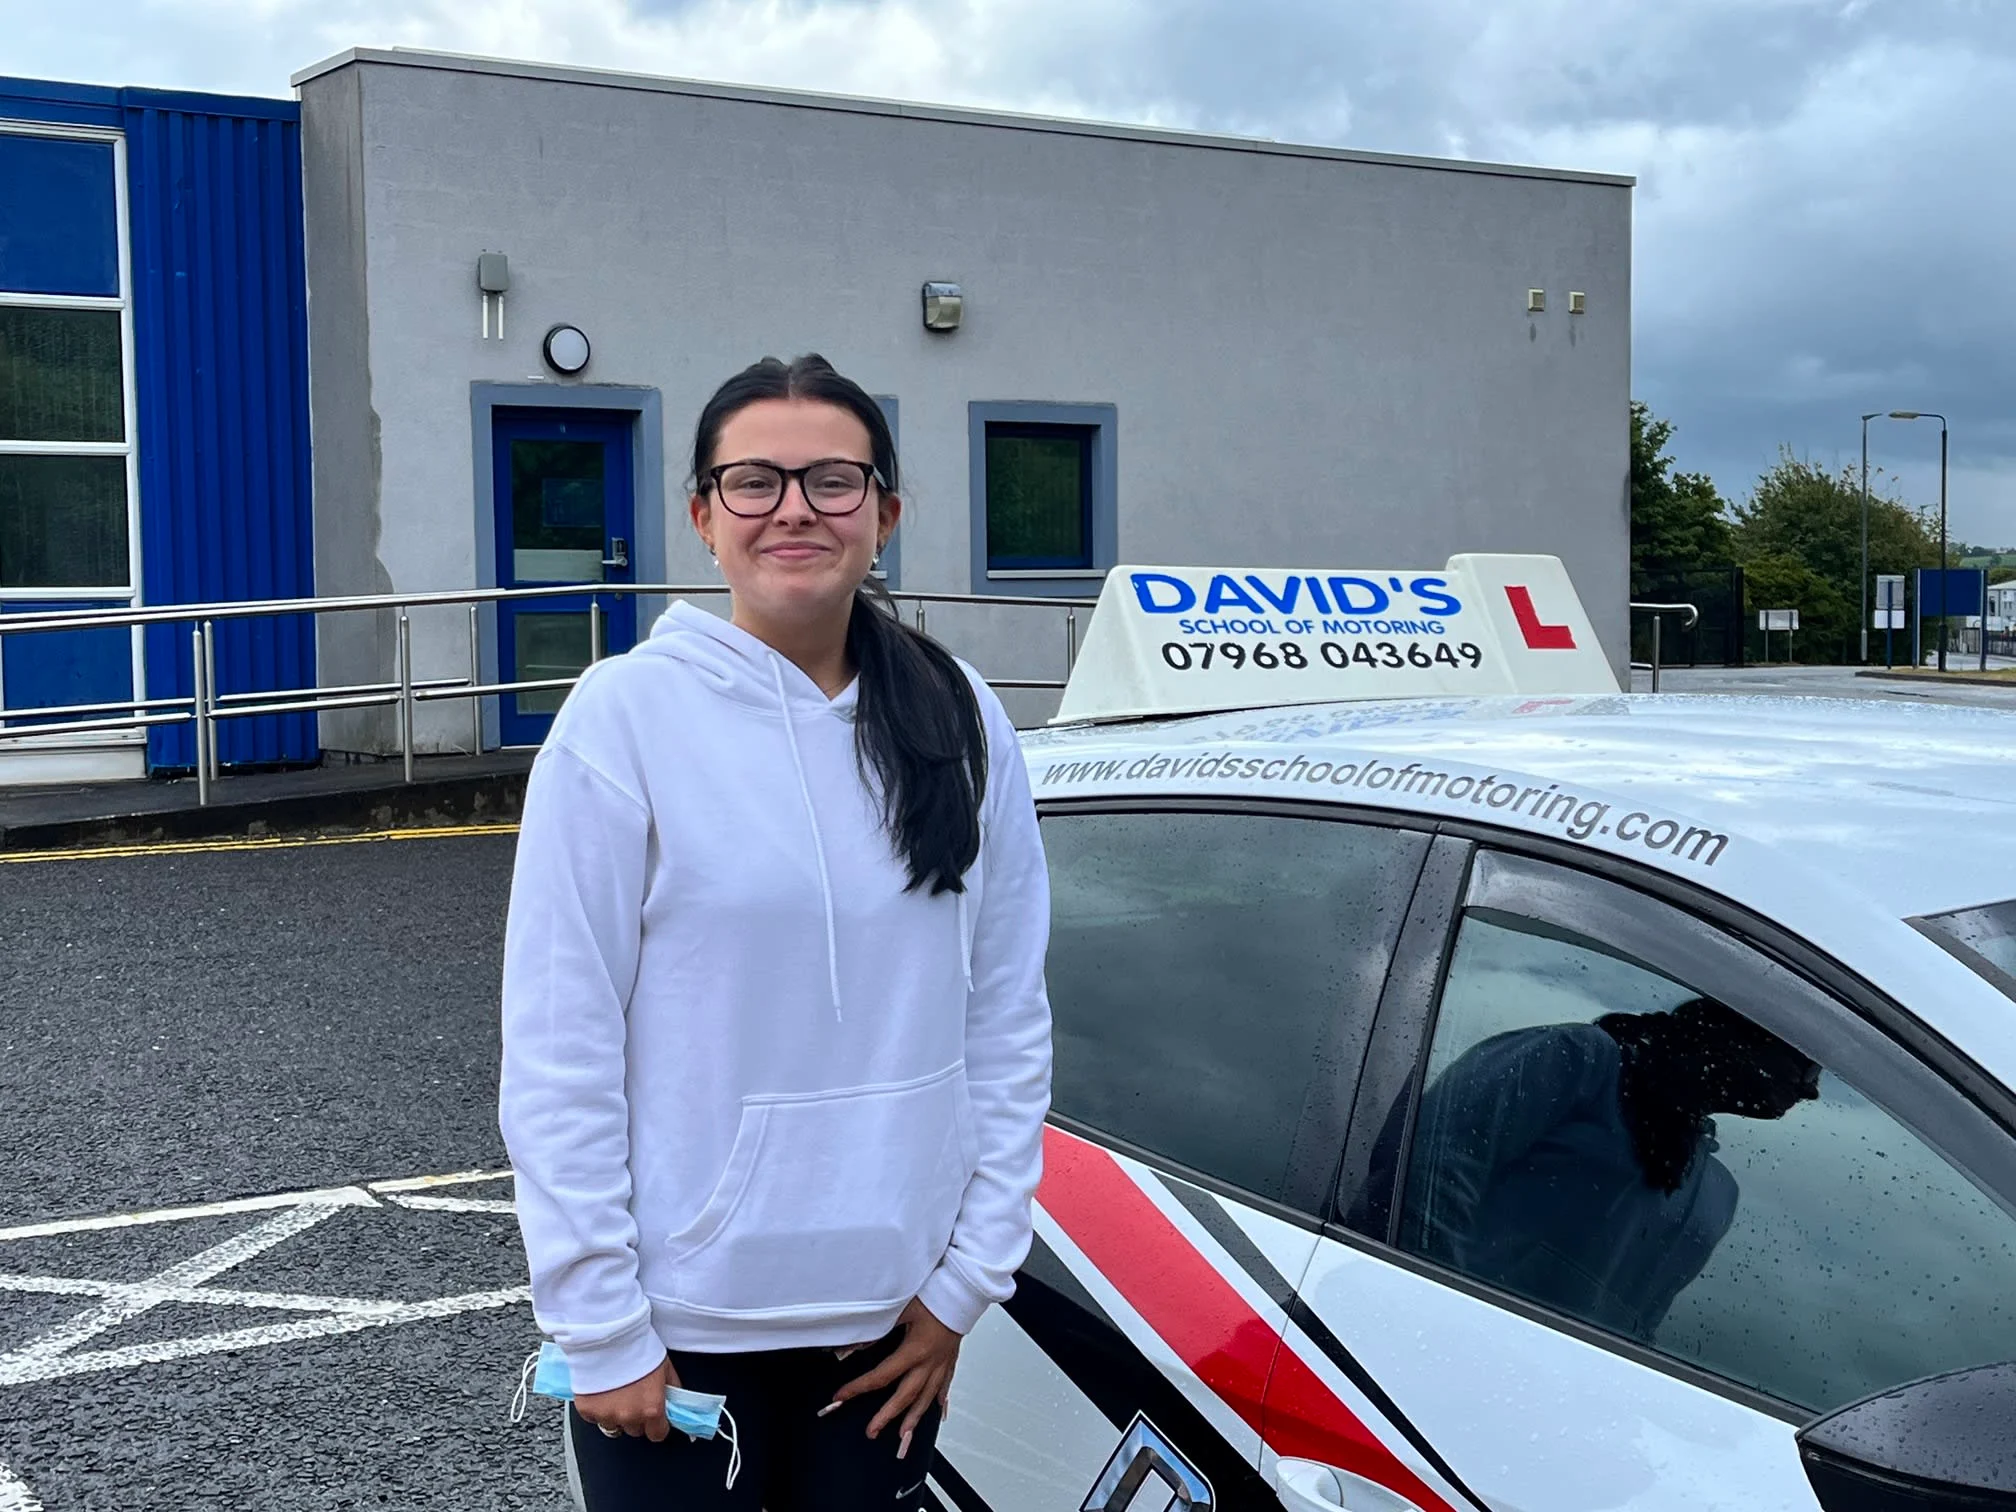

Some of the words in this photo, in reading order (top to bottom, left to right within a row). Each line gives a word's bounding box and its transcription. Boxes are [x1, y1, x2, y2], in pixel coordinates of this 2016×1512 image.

[1130, 573, 1462, 616] DAVID'S
[1178, 619, 1281, 635] SCHOOL
[1284, 620, 1316, 635] OF
[1321, 619, 1446, 636] MOTORING
[1506, 585, 1577, 649] L
[1161, 641, 1309, 671] 07968
[1320, 641, 1483, 670] 043649
[1041, 751, 1730, 867] www.davidsschoolofmotoring.com
